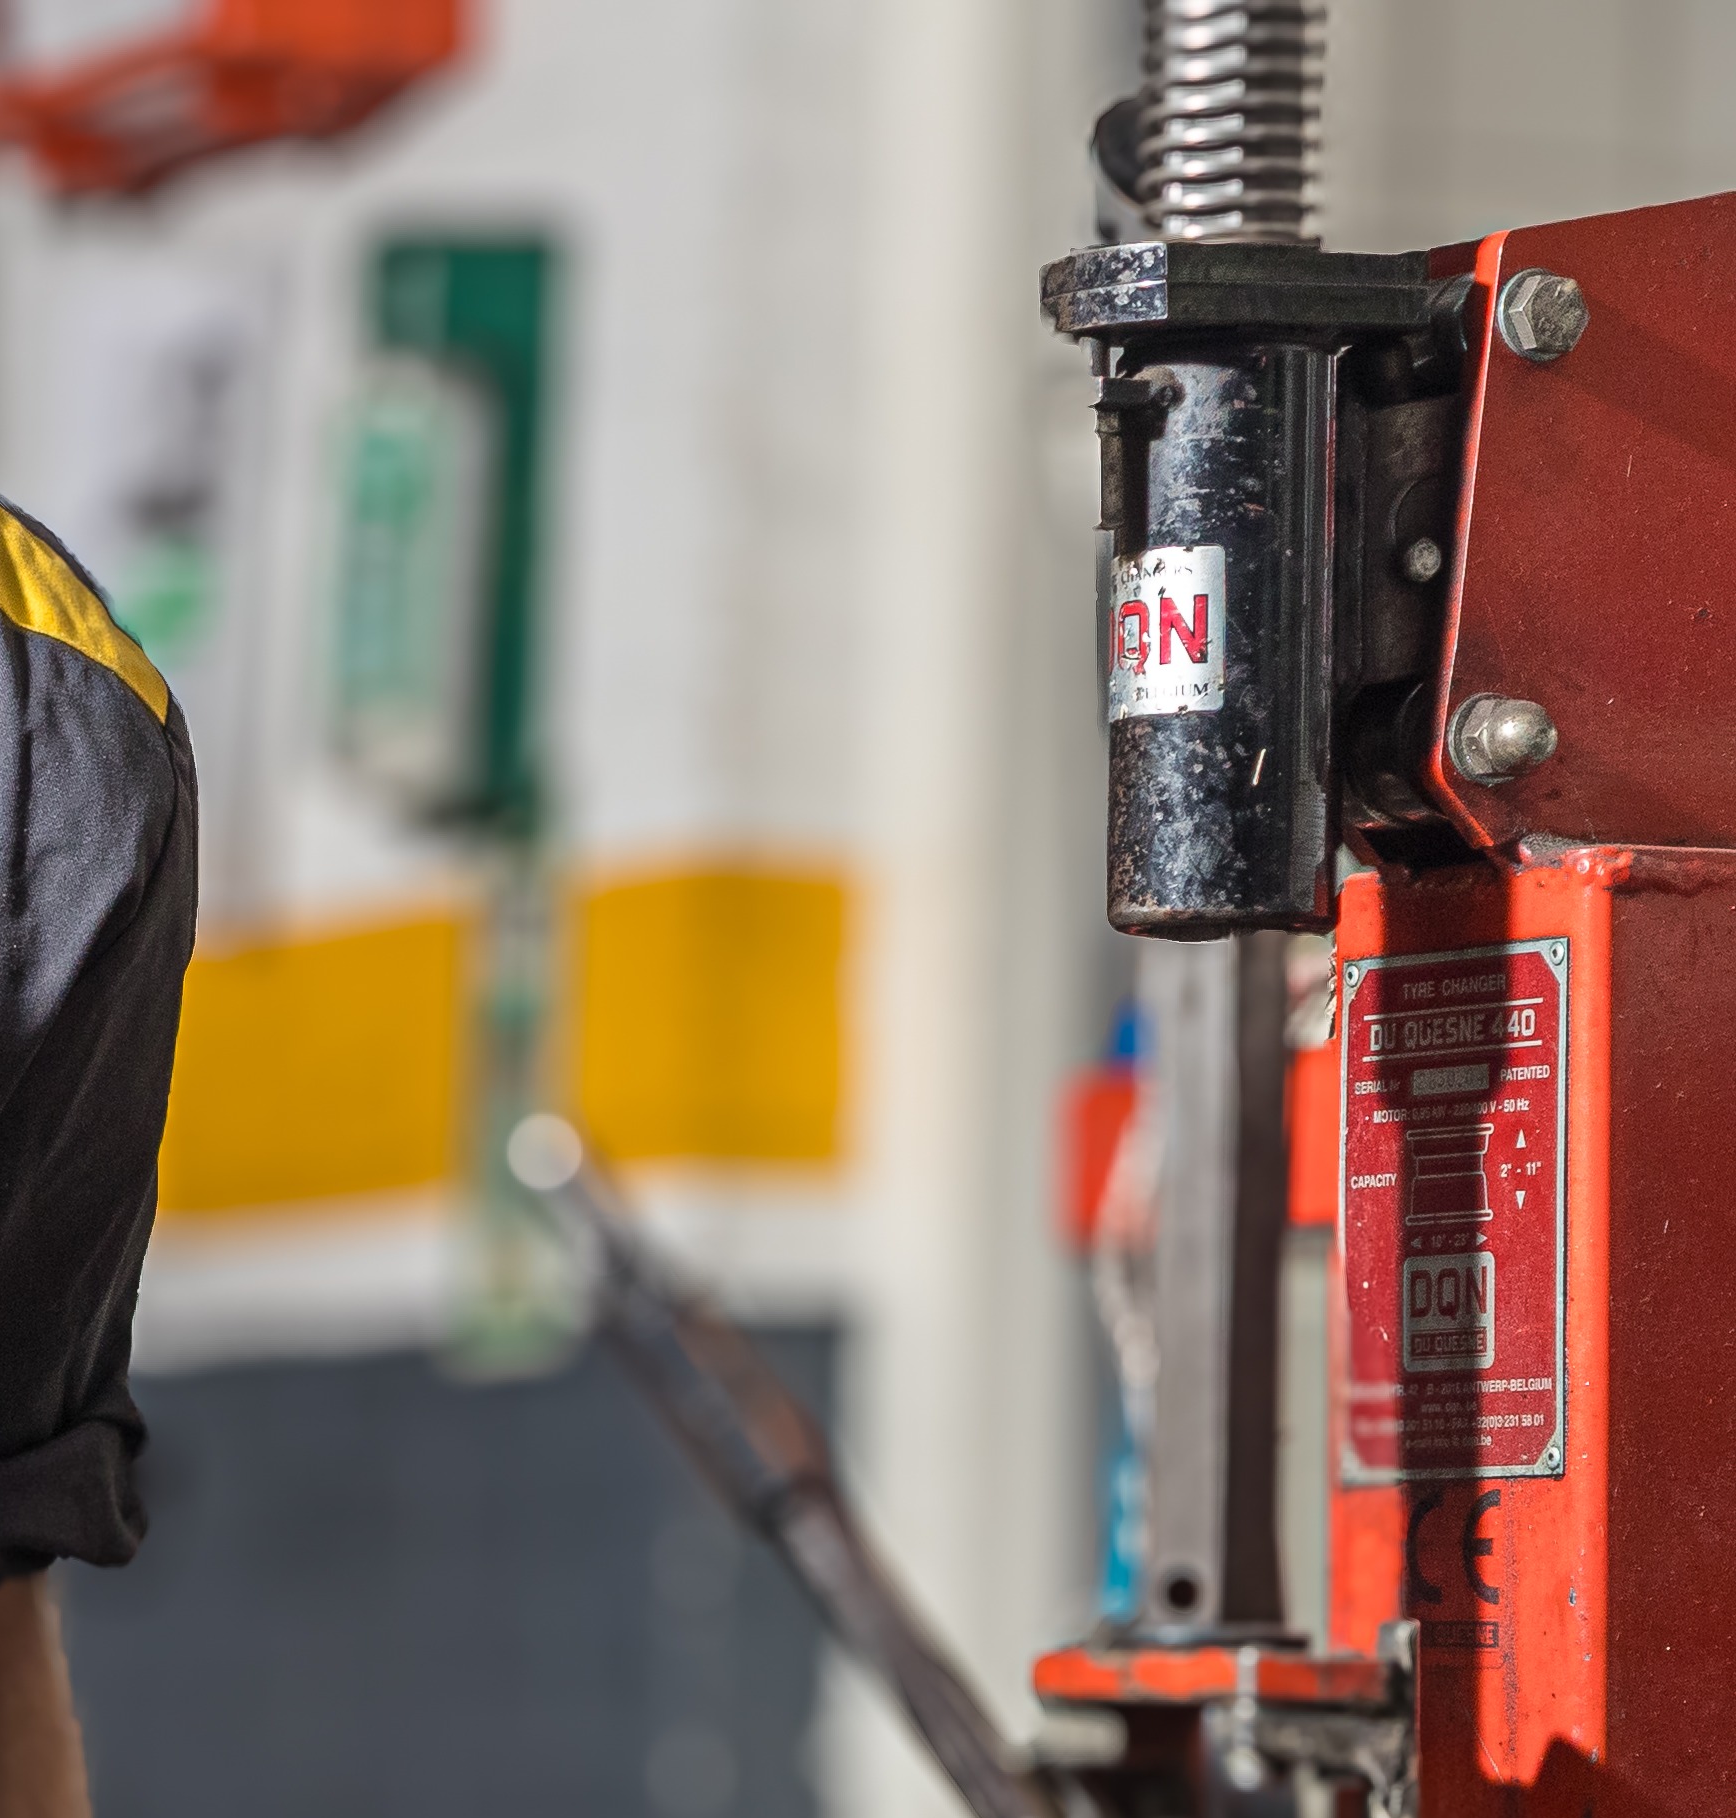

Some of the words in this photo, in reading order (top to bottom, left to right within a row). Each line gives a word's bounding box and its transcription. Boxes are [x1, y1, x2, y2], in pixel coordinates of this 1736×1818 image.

[1108, 593, 1210, 676] QN
[1403, 982, 1435, 999] TYRE
[1442, 975, 1506, 996] CHANGER
[1370, 1023, 1396, 1051] DU
[1405, 1014, 1485, 1049] QUESNE
[1490, 1008, 1536, 1039] 440
[1355, 1081, 1387, 1095] SERIAL
[1501, 1065, 1550, 1080] PATENTED
[1489, 1100, 1498, 1113] V
[1503, 1099, 1516, 1112] 50
[1517, 1097, 1530, 1111] Hz
[1351, 1173, 1397, 1189] CAPACITY
[1409, 1265, 1488, 1321] DQN
[1413, 1337, 1432, 1354] DU
[1433, 1332, 1486, 1353] QUESNE
